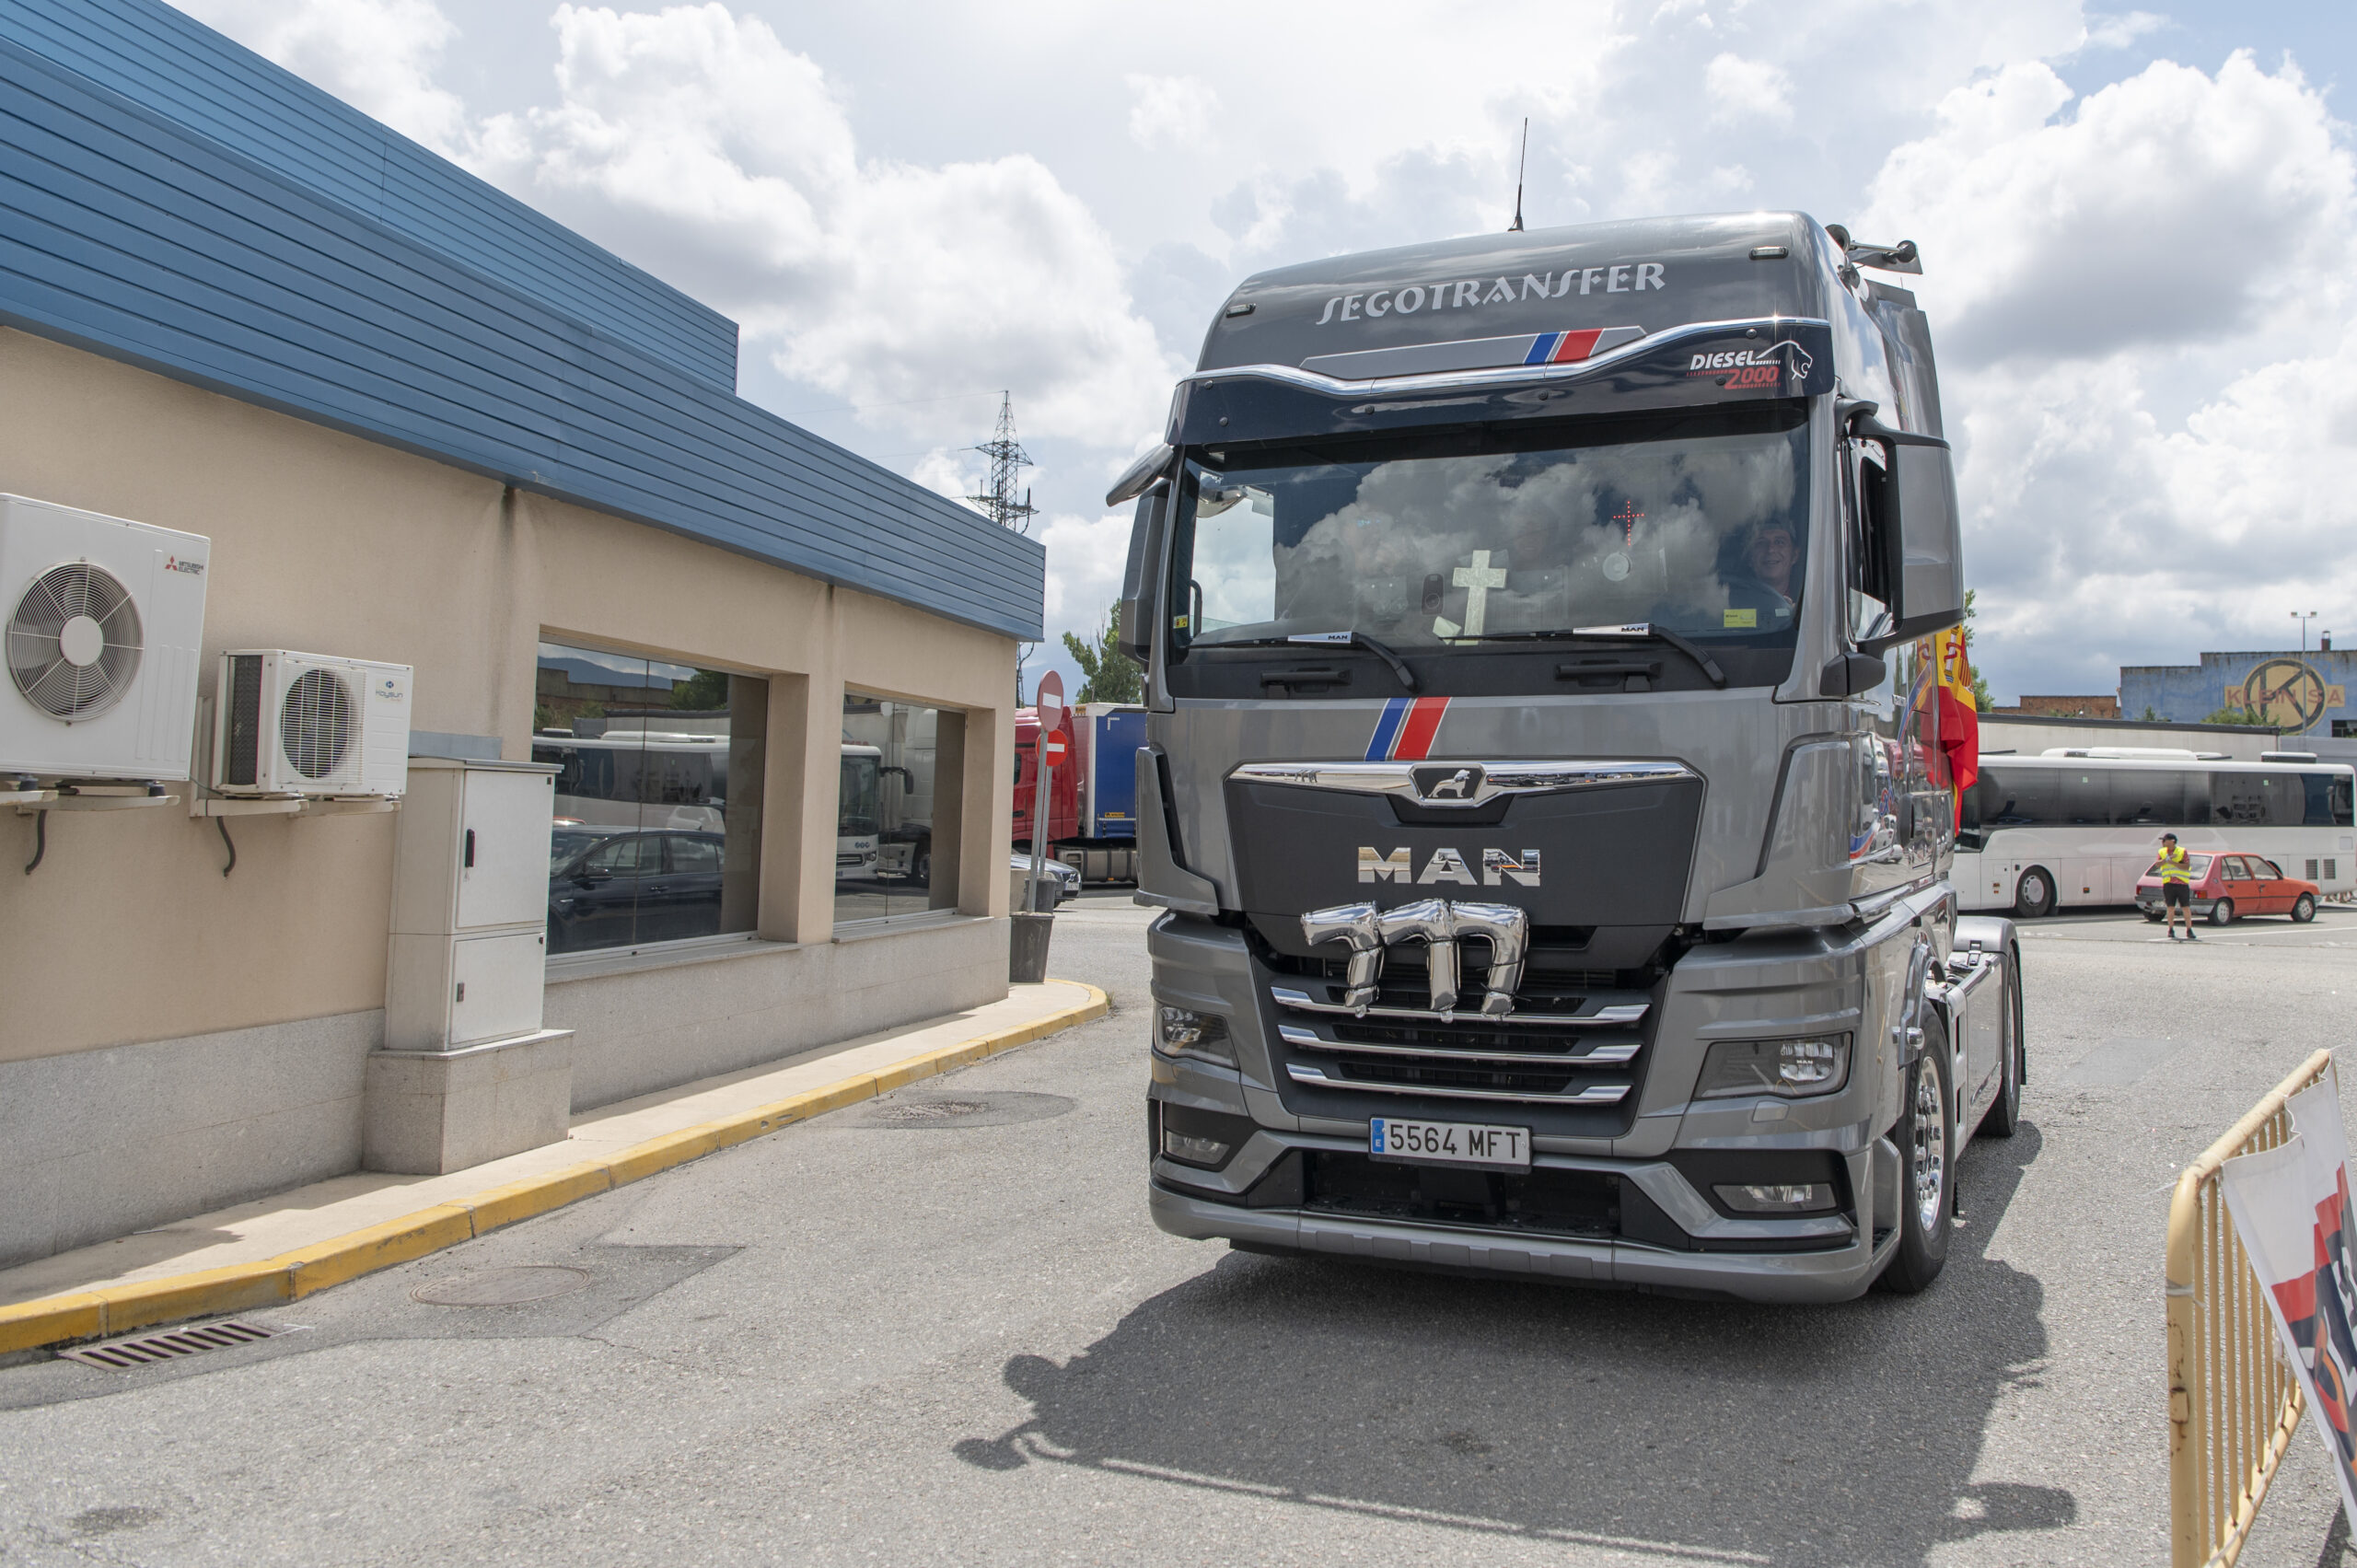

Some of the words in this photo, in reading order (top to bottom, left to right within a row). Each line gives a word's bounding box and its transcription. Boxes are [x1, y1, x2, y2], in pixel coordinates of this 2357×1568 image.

[1316, 263, 1666, 326] SEGOTRANSFER
[1689, 350, 1757, 370] DIESEL
[1724, 366, 1781, 390] 2000
[2226, 689, 2297, 704] KLEIN
[1358, 846, 1541, 887] MAN
[1376, 1139, 1382, 1147] E
[1390, 1124, 1457, 1155] 5564
[1469, 1129, 1521, 1159] MFT
